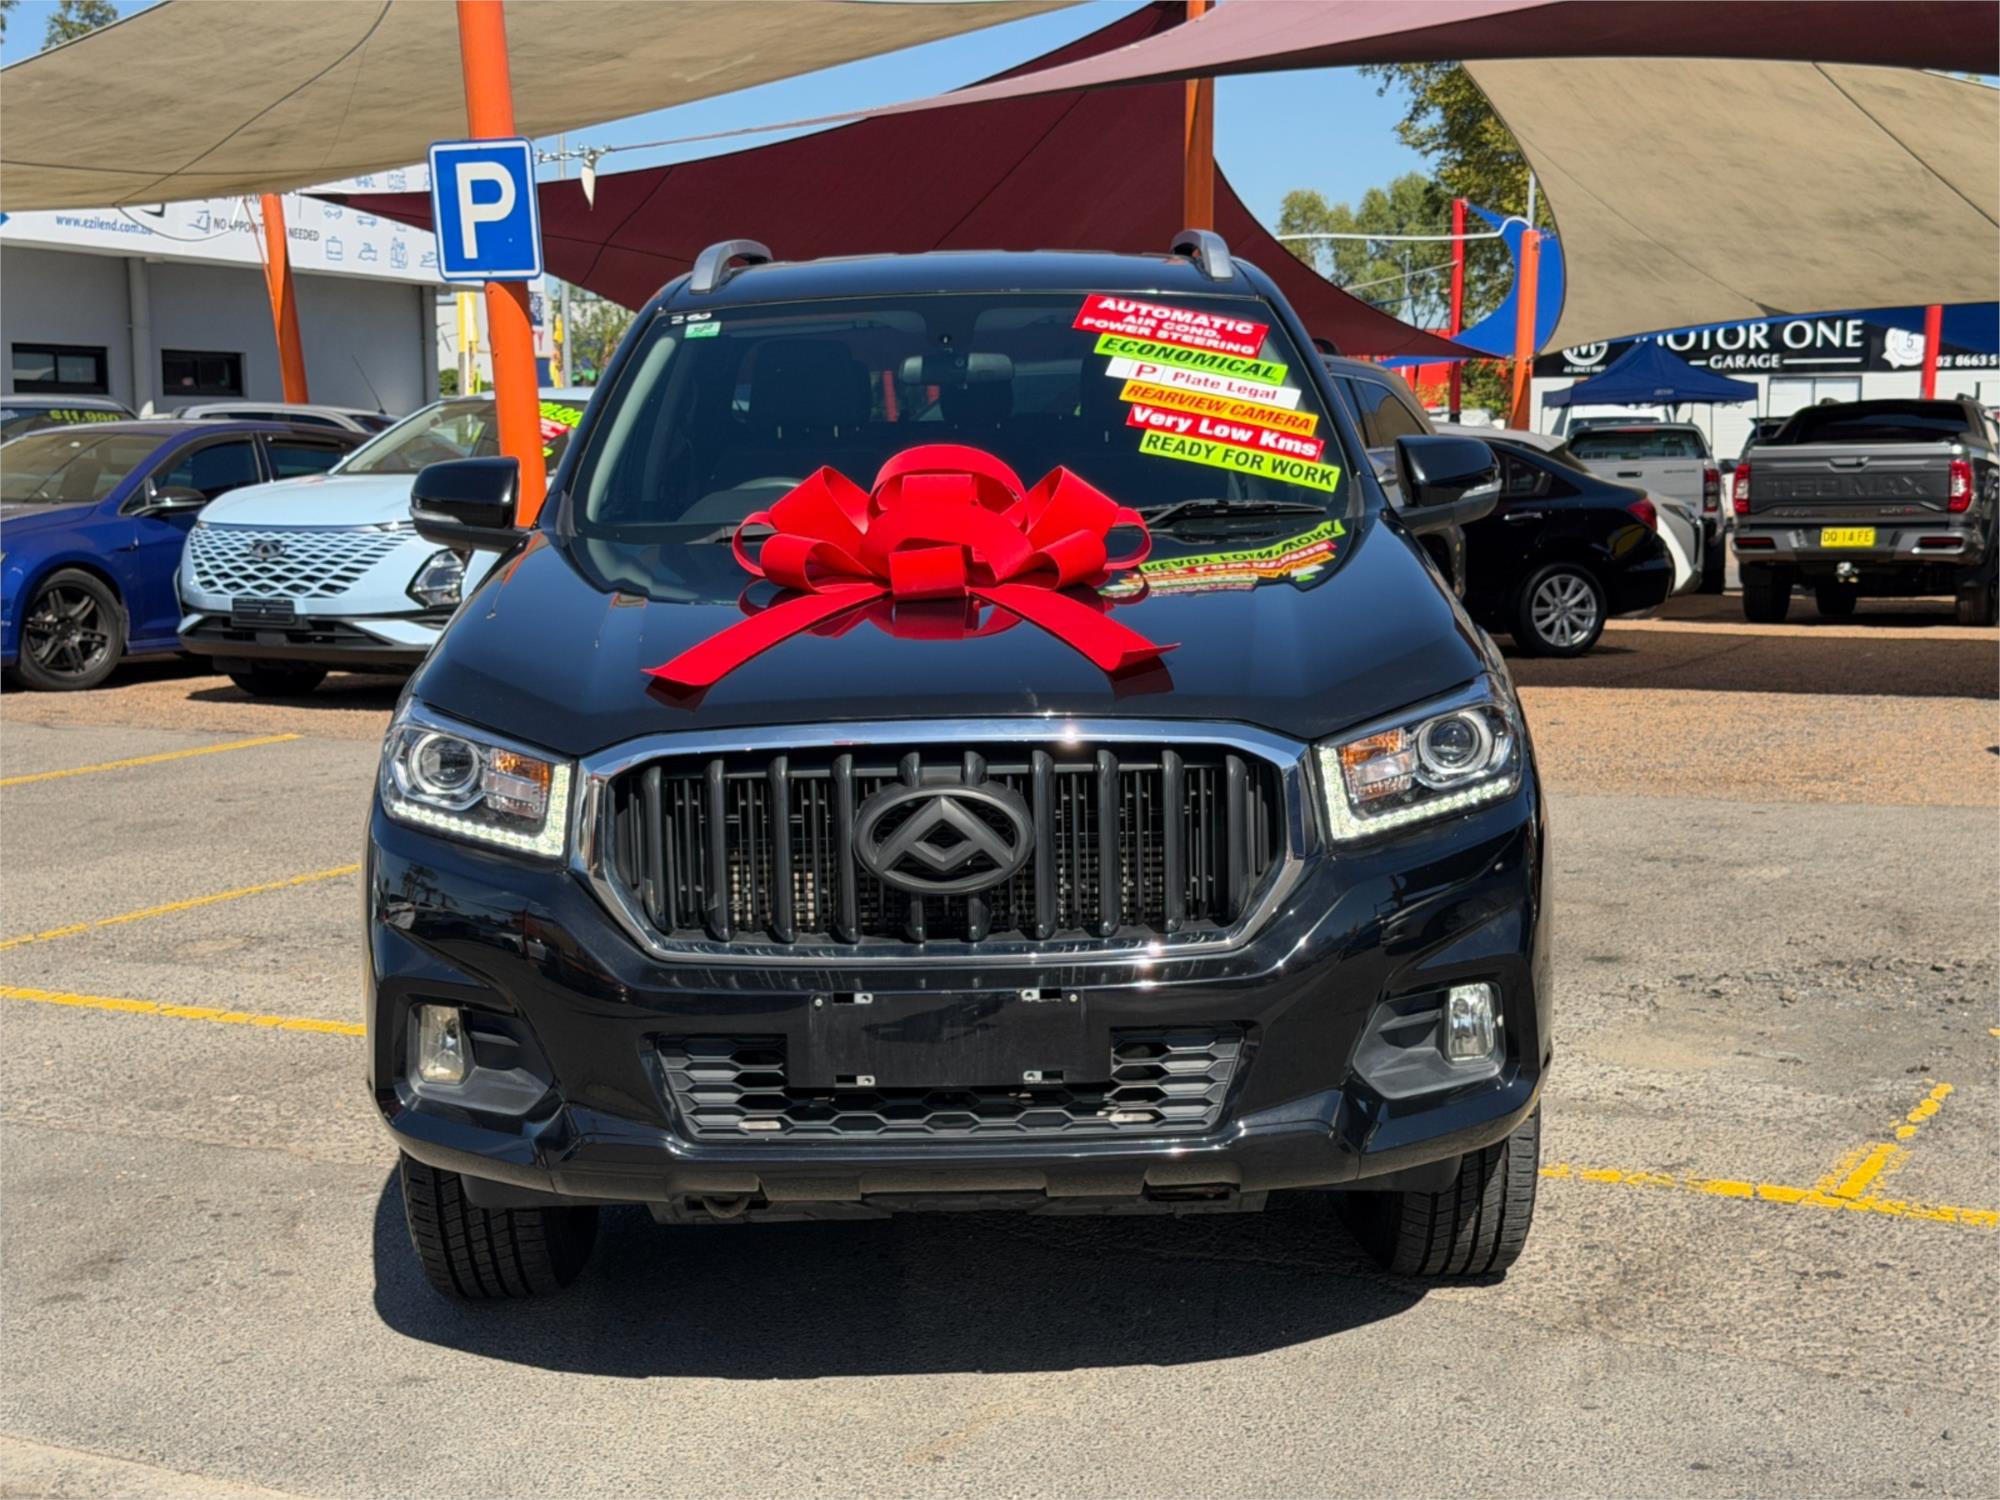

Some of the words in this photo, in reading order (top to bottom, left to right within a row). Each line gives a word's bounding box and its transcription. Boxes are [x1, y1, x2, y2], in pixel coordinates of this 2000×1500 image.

[455, 161, 516, 259] P
[213, 218, 228, 230] NO
[288, 228, 320, 241] NEEDED
[1098, 298, 1254, 335] AUTOMATIC
[1123, 314, 1157, 328] AIR
[1162, 321, 1221, 339] COND.
[1635, 322, 1770, 350] OTOR
[1782, 320, 1864, 349] ONE
[1082, 317, 1152, 336] POWER
[1156, 329, 1255, 355] STEERING
[1102, 337, 1277, 378] ECONOMICAL
[1709, 354, 1780, 369] GARAGE
[1135, 364, 1157, 378] P
[1172, 372, 1221, 389] Plate
[1227, 382, 1277, 400] Legal
[1126, 384, 1226, 411] REARVIEW
[1229, 403, 1312, 430] CAMERA
[1133, 406, 1193, 432] Very
[1198, 419, 1254, 442] Low
[1259, 432, 1318, 457] Kms
[1146, 434, 1217, 460] READY
[1222, 449, 1264, 470] FOR
[1271, 459, 1335, 486] WORK
